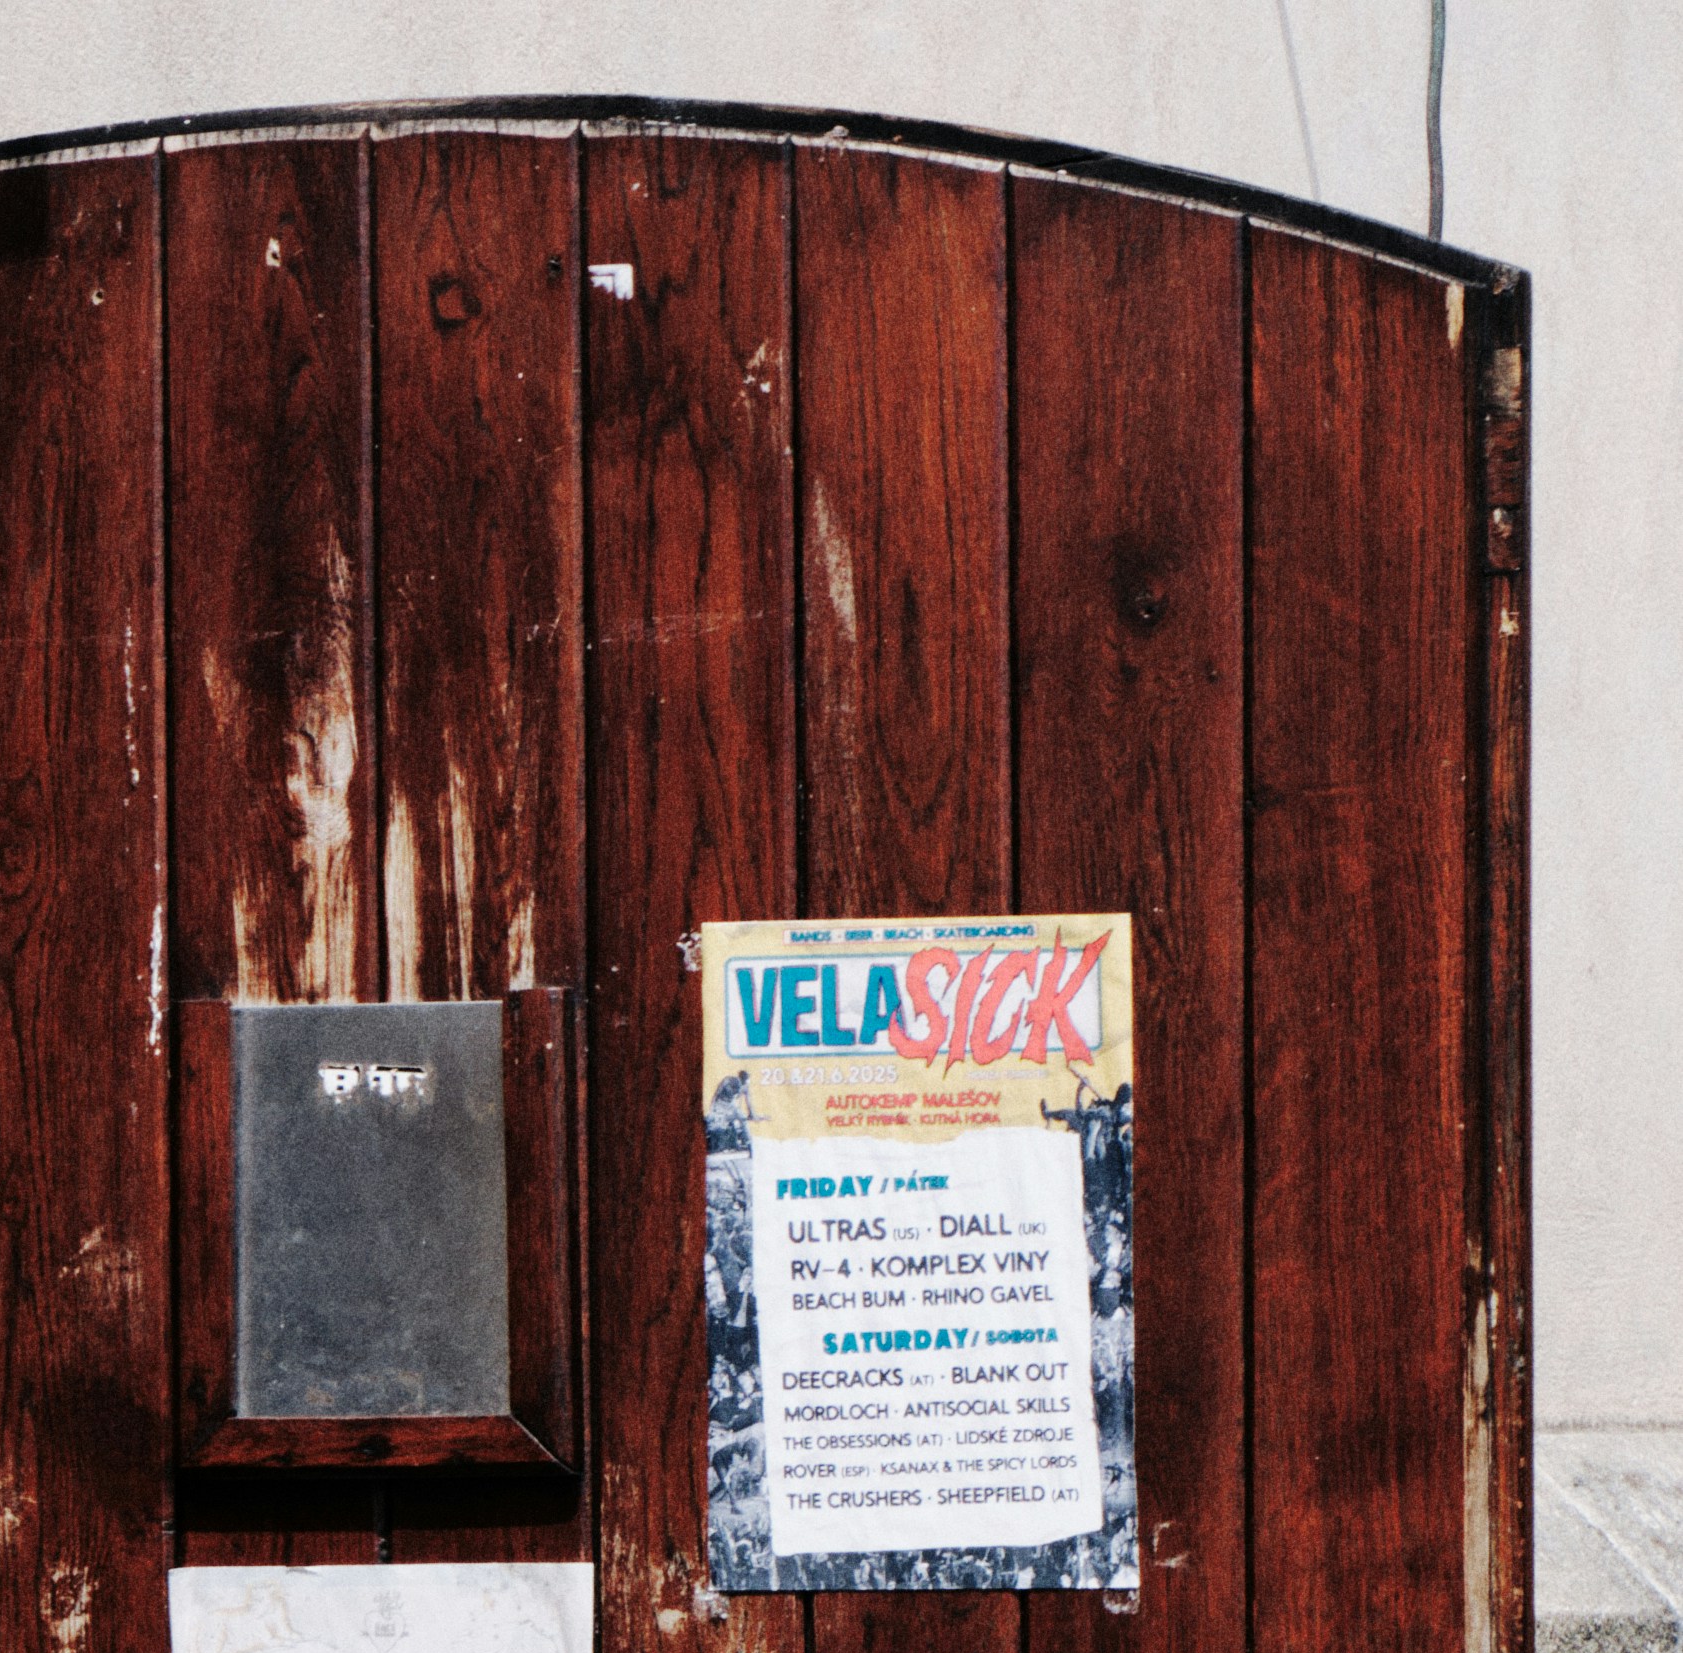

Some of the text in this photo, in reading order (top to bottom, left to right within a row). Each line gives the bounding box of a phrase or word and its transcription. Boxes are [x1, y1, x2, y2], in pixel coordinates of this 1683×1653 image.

[826, 1089, 1002, 1112] AUTOKEMP MALEŠOV
[776, 1176, 873, 1200] FRIDAY
[893, 1169, 950, 1193] PÁTEK
[788, 1213, 1047, 1244] ULTRAS (US) DIALL (UK)
[871, 1253, 988, 1279] KOMPLEX
[993, 1250, 1050, 1274] VINY
[793, 1284, 1054, 1312] BEACH BUM RHINO GAVEL
[822, 1328, 970, 1356] SATURDAY
[985, 1327, 1059, 1345] SOBOTA
[782, 1367, 904, 1391] DEECRACKS
[951, 1364, 1021, 1385] BLANK
[1025, 1361, 1069, 1382] OUT
[783, 1396, 1071, 1423] MORDLOCH ANTISOCIAL SKILLS
[783, 1425, 1074, 1451] THE OBSESSIONS (AT) LIDSKÉ ZDROJE
[783, 1454, 1078, 1480] ROVER (ESP) KSANAX & THE SPICY LORDS
[786, 1485, 1080, 1510] THE CRUSHERS SHEEPFIELD (AT)
